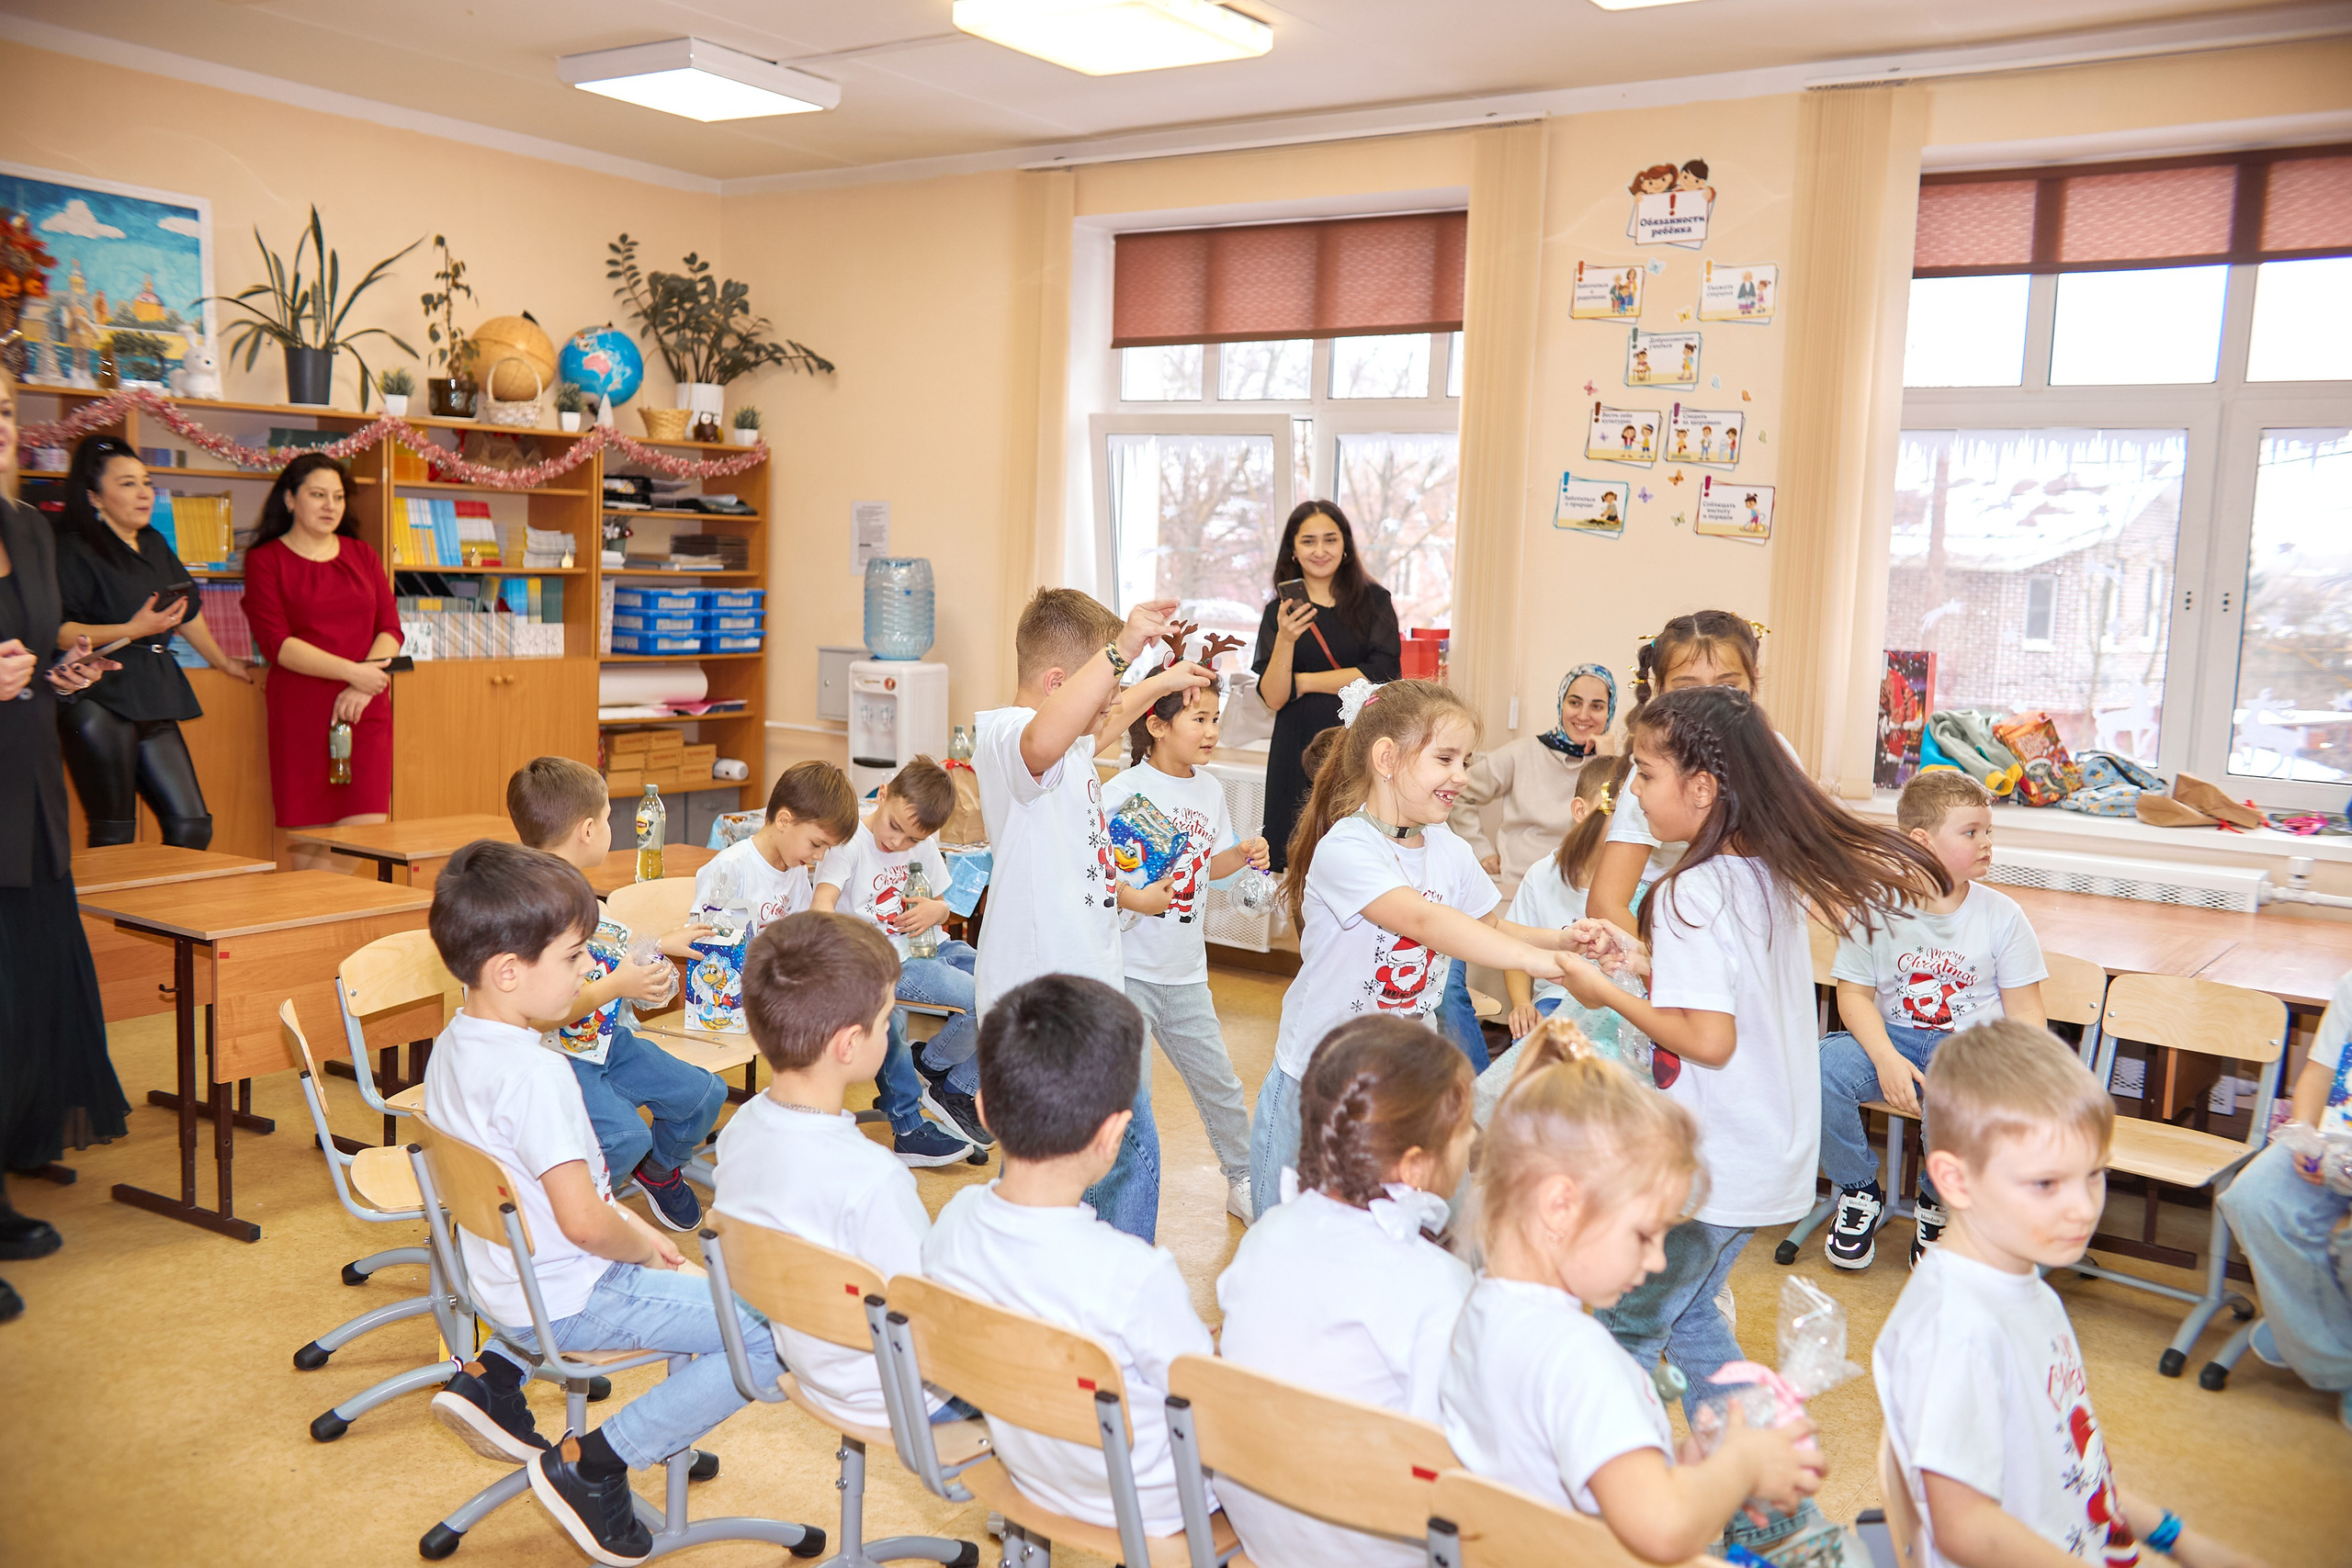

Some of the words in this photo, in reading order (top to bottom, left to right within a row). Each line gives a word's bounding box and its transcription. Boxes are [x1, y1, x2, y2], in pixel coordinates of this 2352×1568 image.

[1640, 215, 1705, 227] Обязанности
[1651, 226, 1692, 238] ребёнка
[1182, 807, 1209, 827] Merry
[1926, 947, 1965, 964] Merry
[1897, 953, 1978, 987] Christmas
